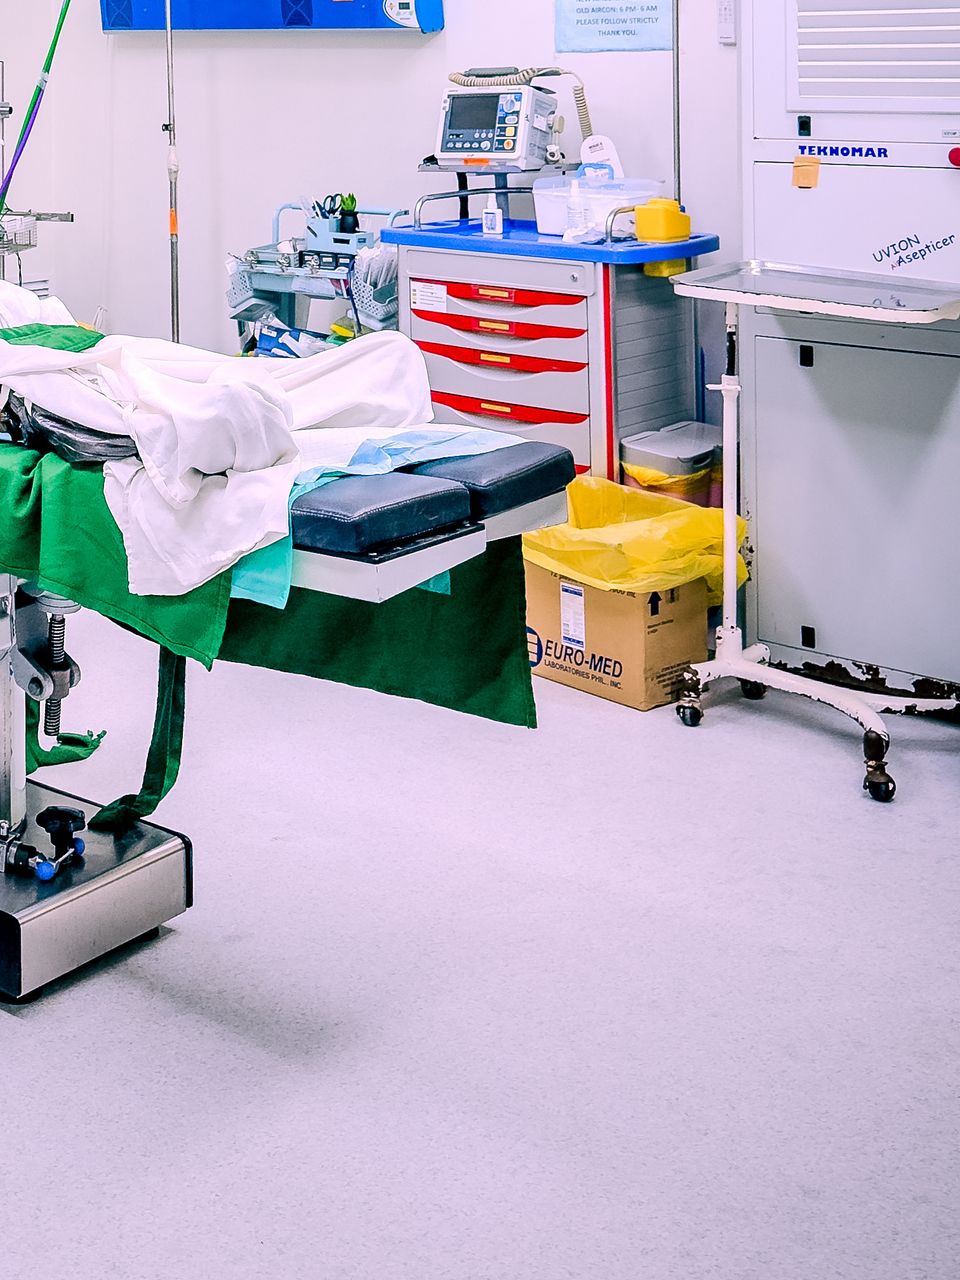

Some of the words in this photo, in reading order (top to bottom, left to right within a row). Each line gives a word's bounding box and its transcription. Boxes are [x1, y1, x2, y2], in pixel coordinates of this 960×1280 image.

[591, 6, 618, 14] AIRCON:
[798, 145, 888, 158] TEKNOMAR
[872, 234, 920, 262] UVION
[897, 234, 955, 266] Asepticer
[544, 639, 623, 678] EURO-MED
[544, 660, 591, 680] LABORATORIES
